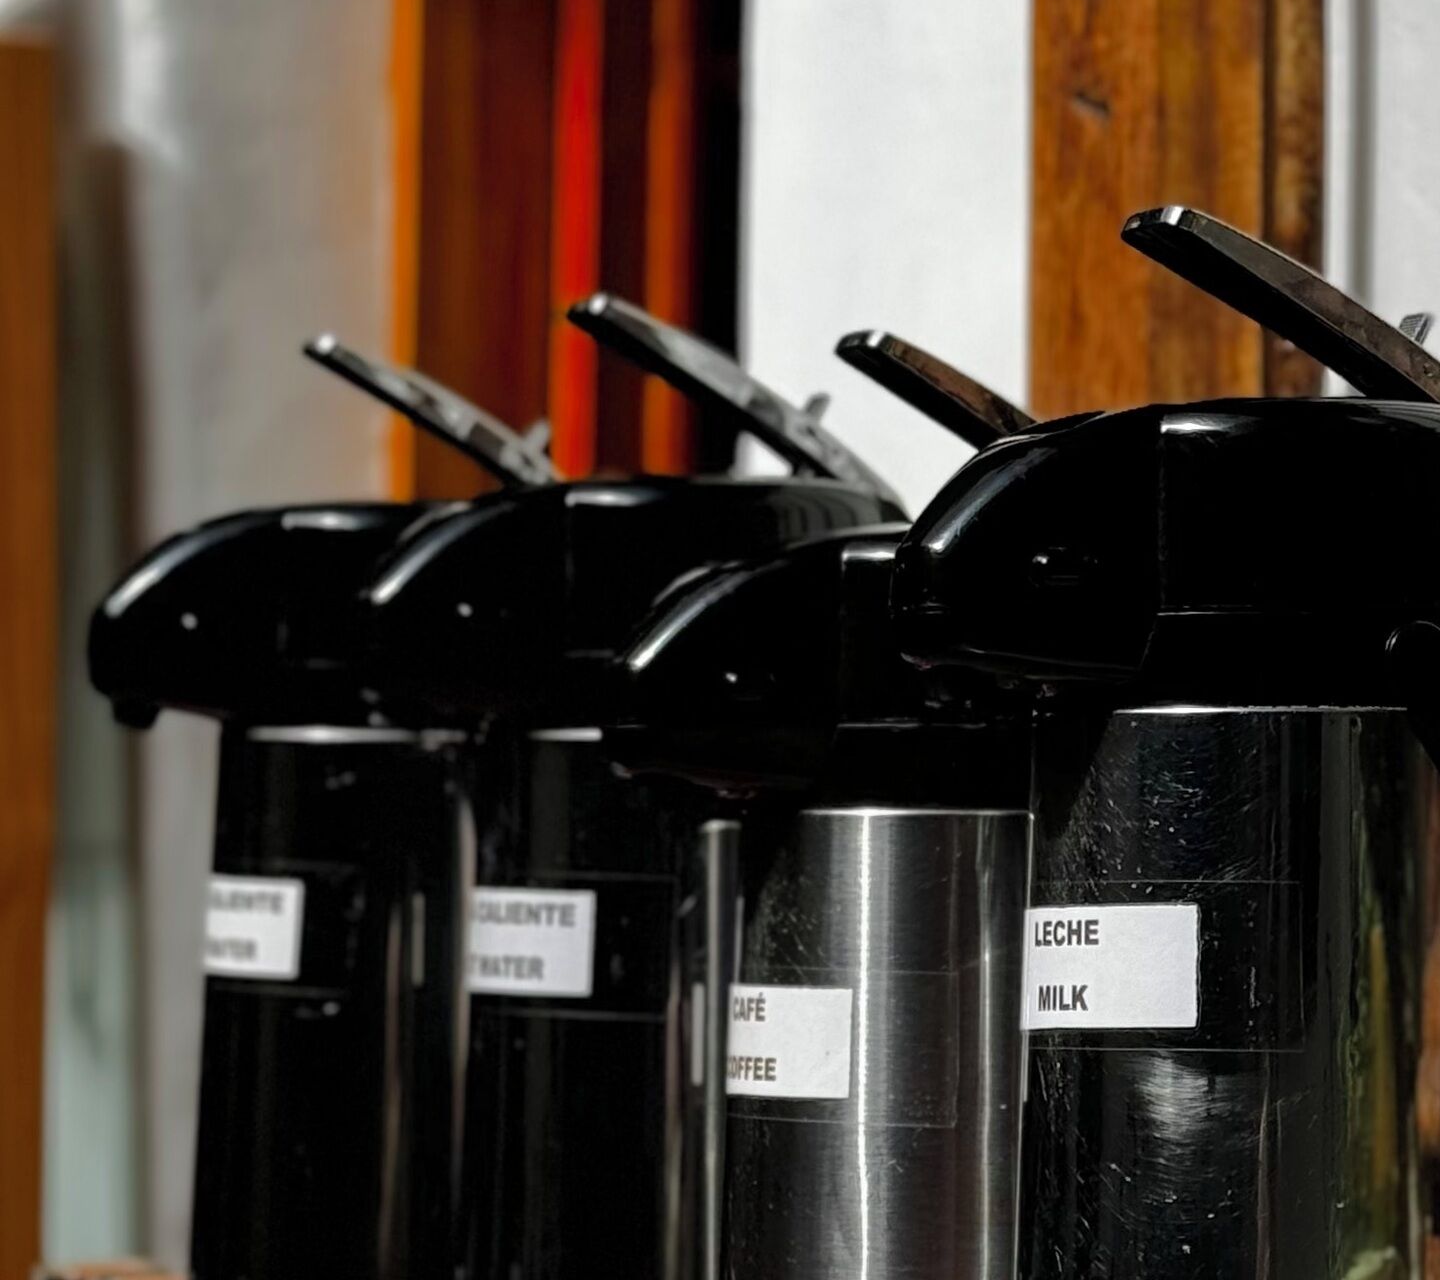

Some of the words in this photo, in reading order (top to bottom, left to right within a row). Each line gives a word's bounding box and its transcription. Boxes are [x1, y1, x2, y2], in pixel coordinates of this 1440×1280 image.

[1034, 919, 1100, 948] LECHE
[733, 991, 767, 1022] CAFÉ
[1037, 984, 1089, 1012] MILK
